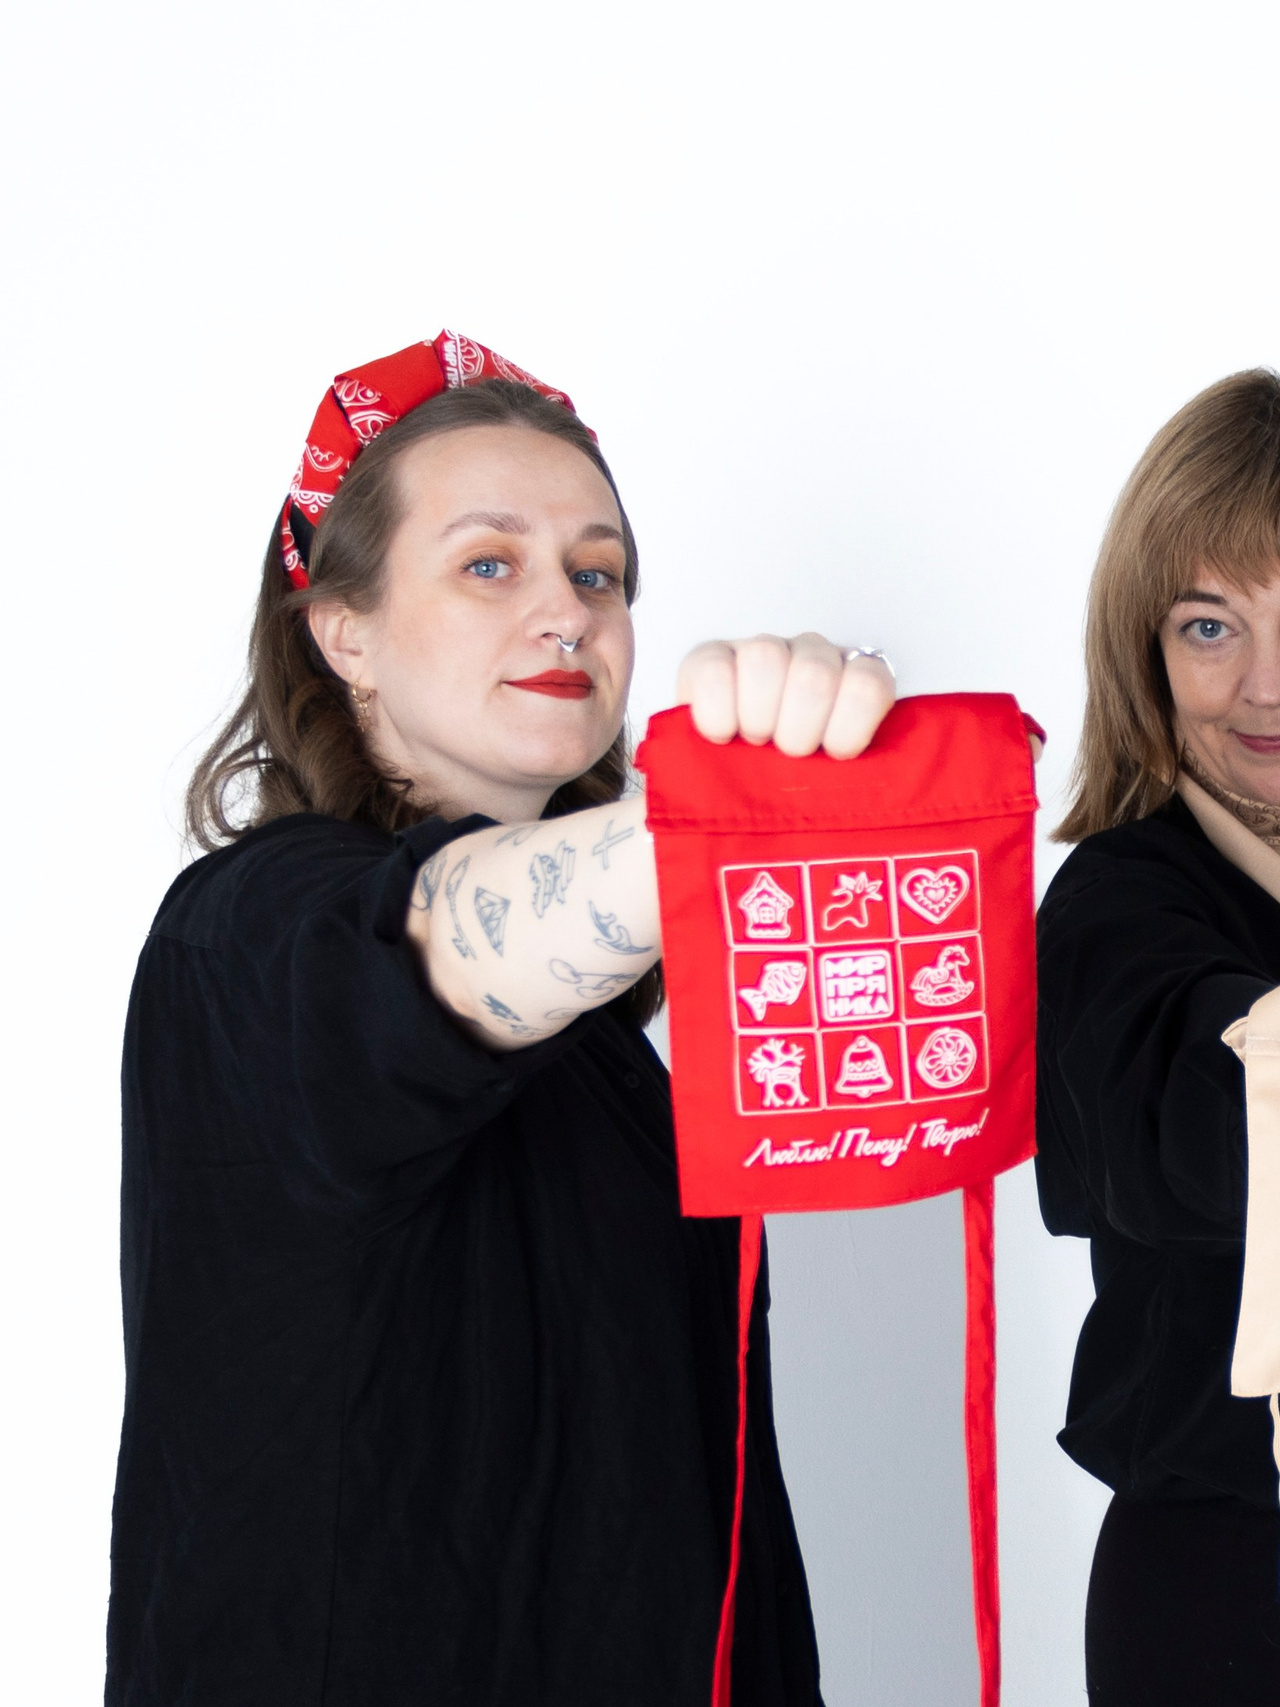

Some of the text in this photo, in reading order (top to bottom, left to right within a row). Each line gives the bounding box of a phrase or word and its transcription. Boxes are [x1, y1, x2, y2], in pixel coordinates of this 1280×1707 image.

[827, 954, 885, 975] МИР
[827, 977, 885, 996] ПРЯ
[828, 997, 888, 1016] НИКА
[743, 1108, 990, 1167] Люблю! Пеку! Творю!
